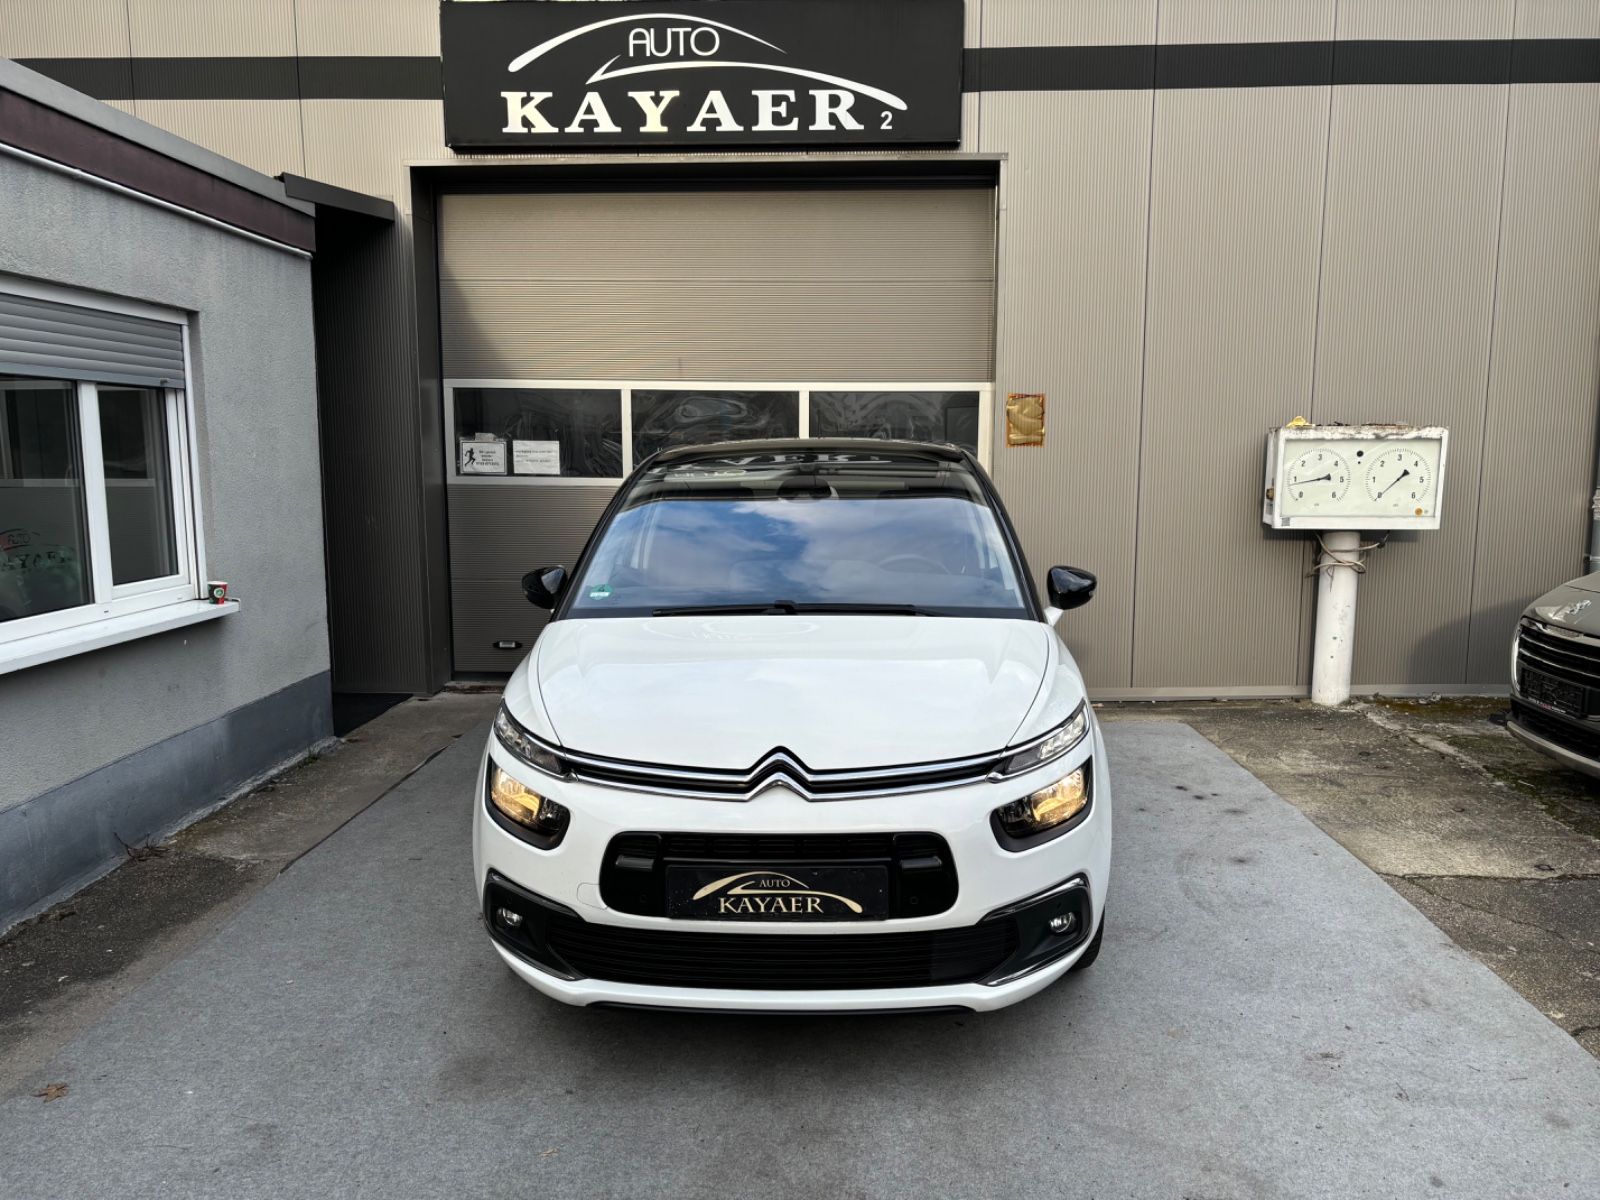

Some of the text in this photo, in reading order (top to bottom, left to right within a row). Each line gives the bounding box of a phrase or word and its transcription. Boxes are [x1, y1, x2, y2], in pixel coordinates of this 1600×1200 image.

[628, 27, 720, 57] AUTO
[501, 89, 893, 133] KAYAER 2
[759, 879, 791, 888] AUTO
[719, 897, 823, 914] KAYAER
